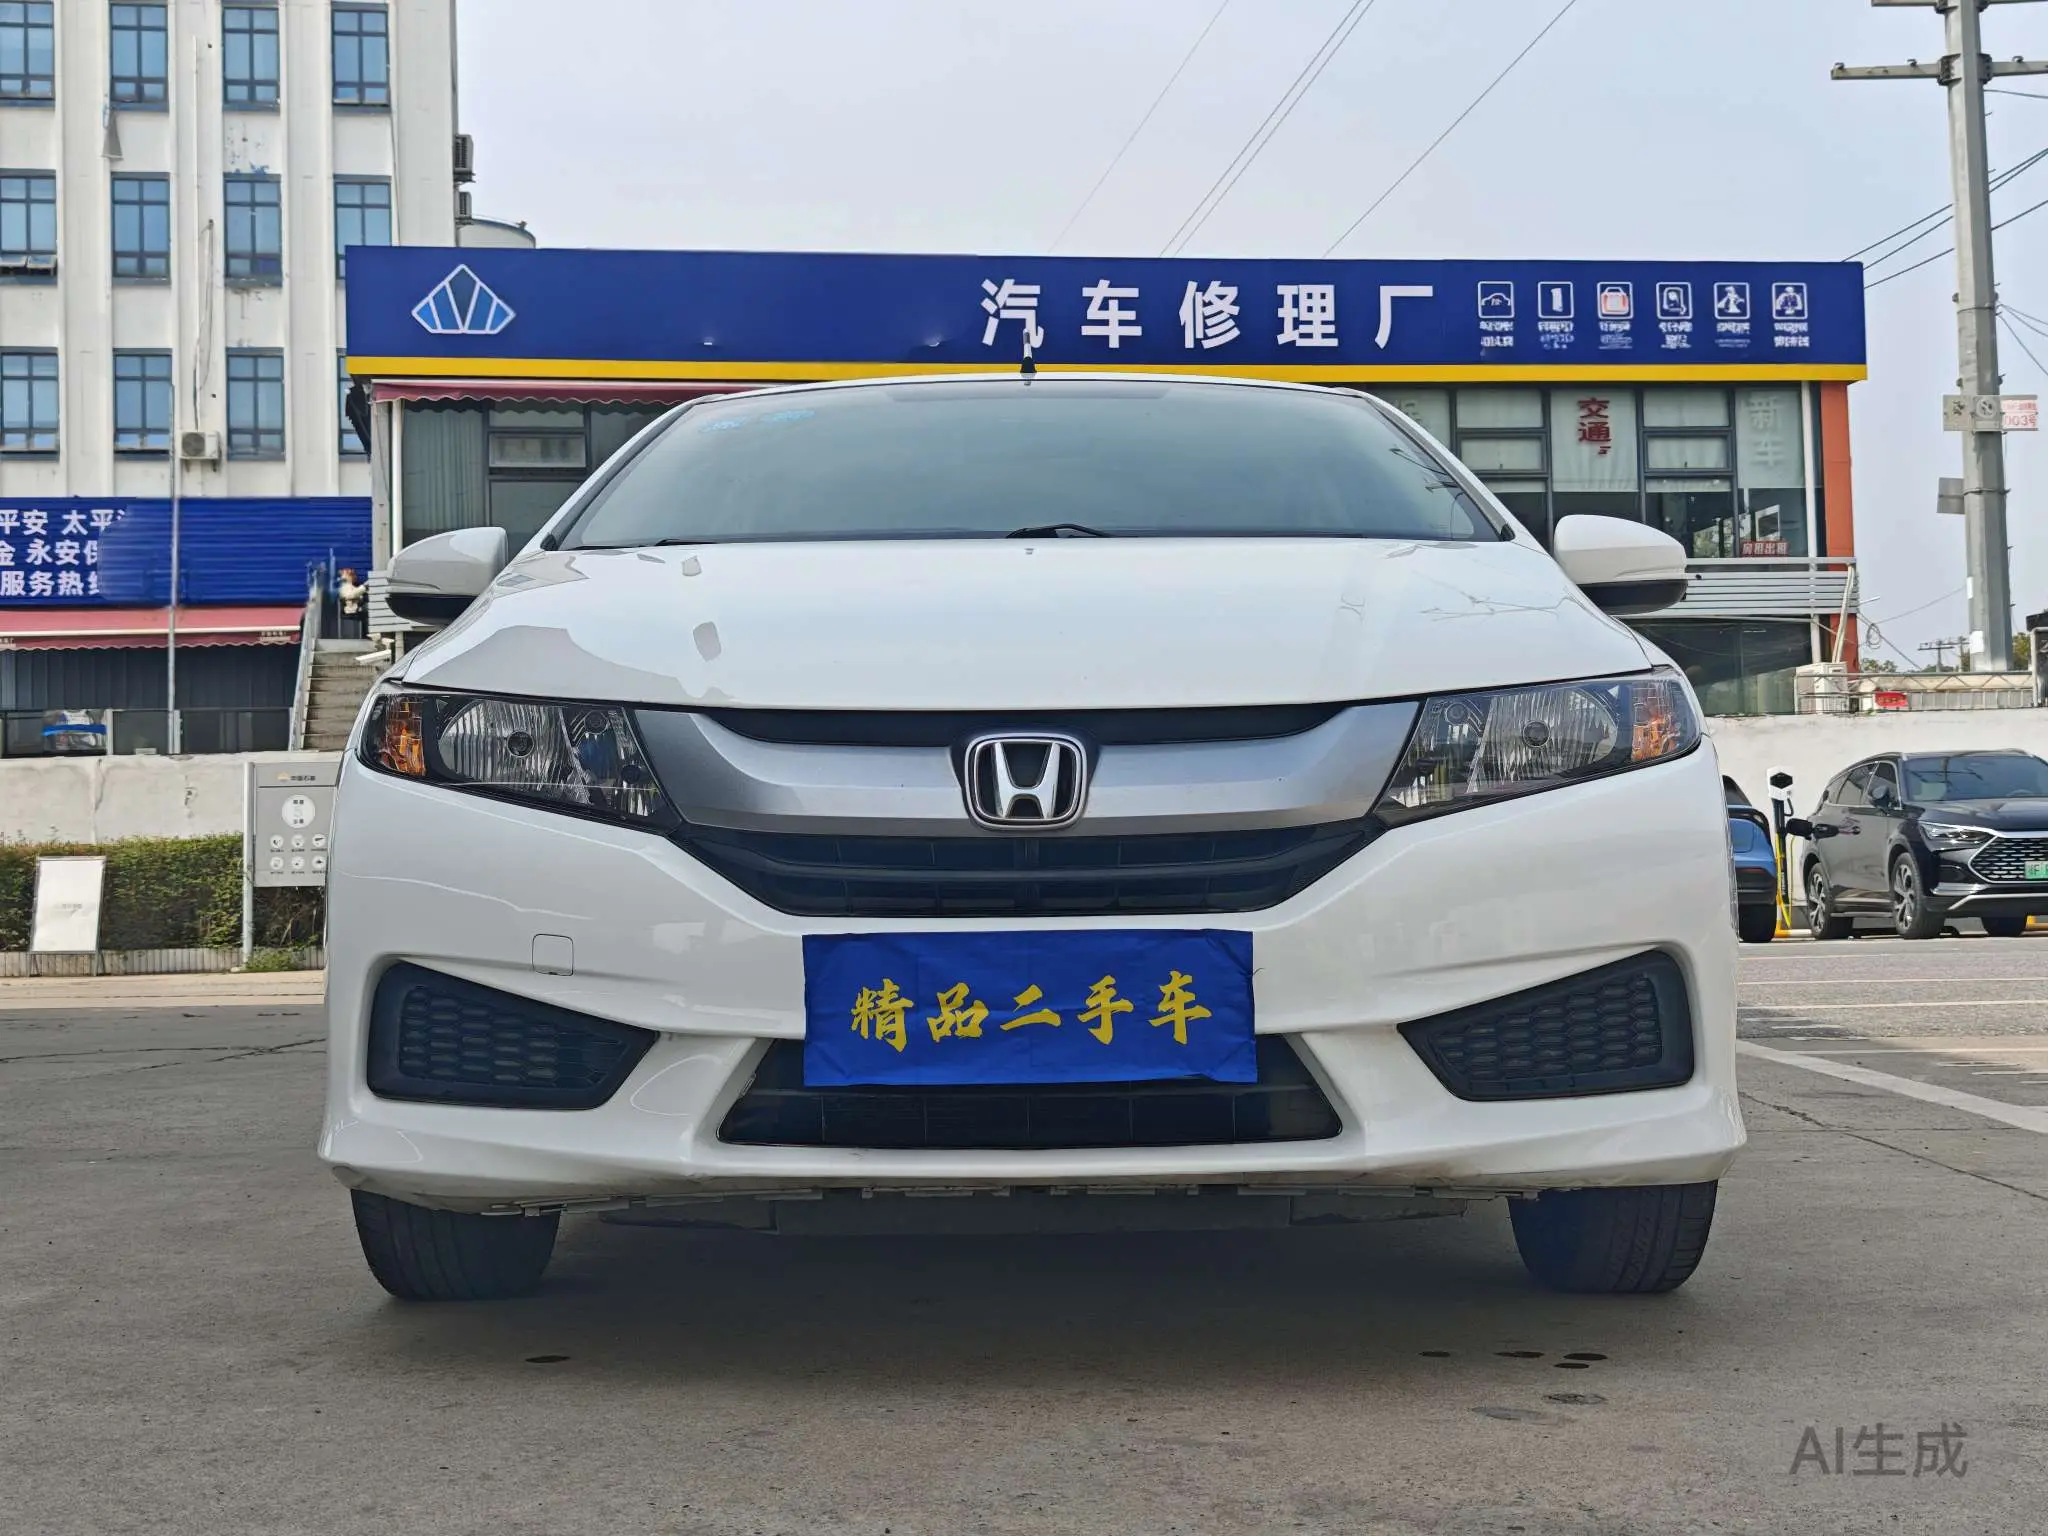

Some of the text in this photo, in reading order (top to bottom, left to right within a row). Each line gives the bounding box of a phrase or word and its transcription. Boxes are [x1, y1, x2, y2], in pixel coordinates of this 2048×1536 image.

[980, 278, 1434, 349] 汽车修理厂
[0, 509, 126, 535] 平安 太平
[850, 970, 1213, 1053] 精品二手车
